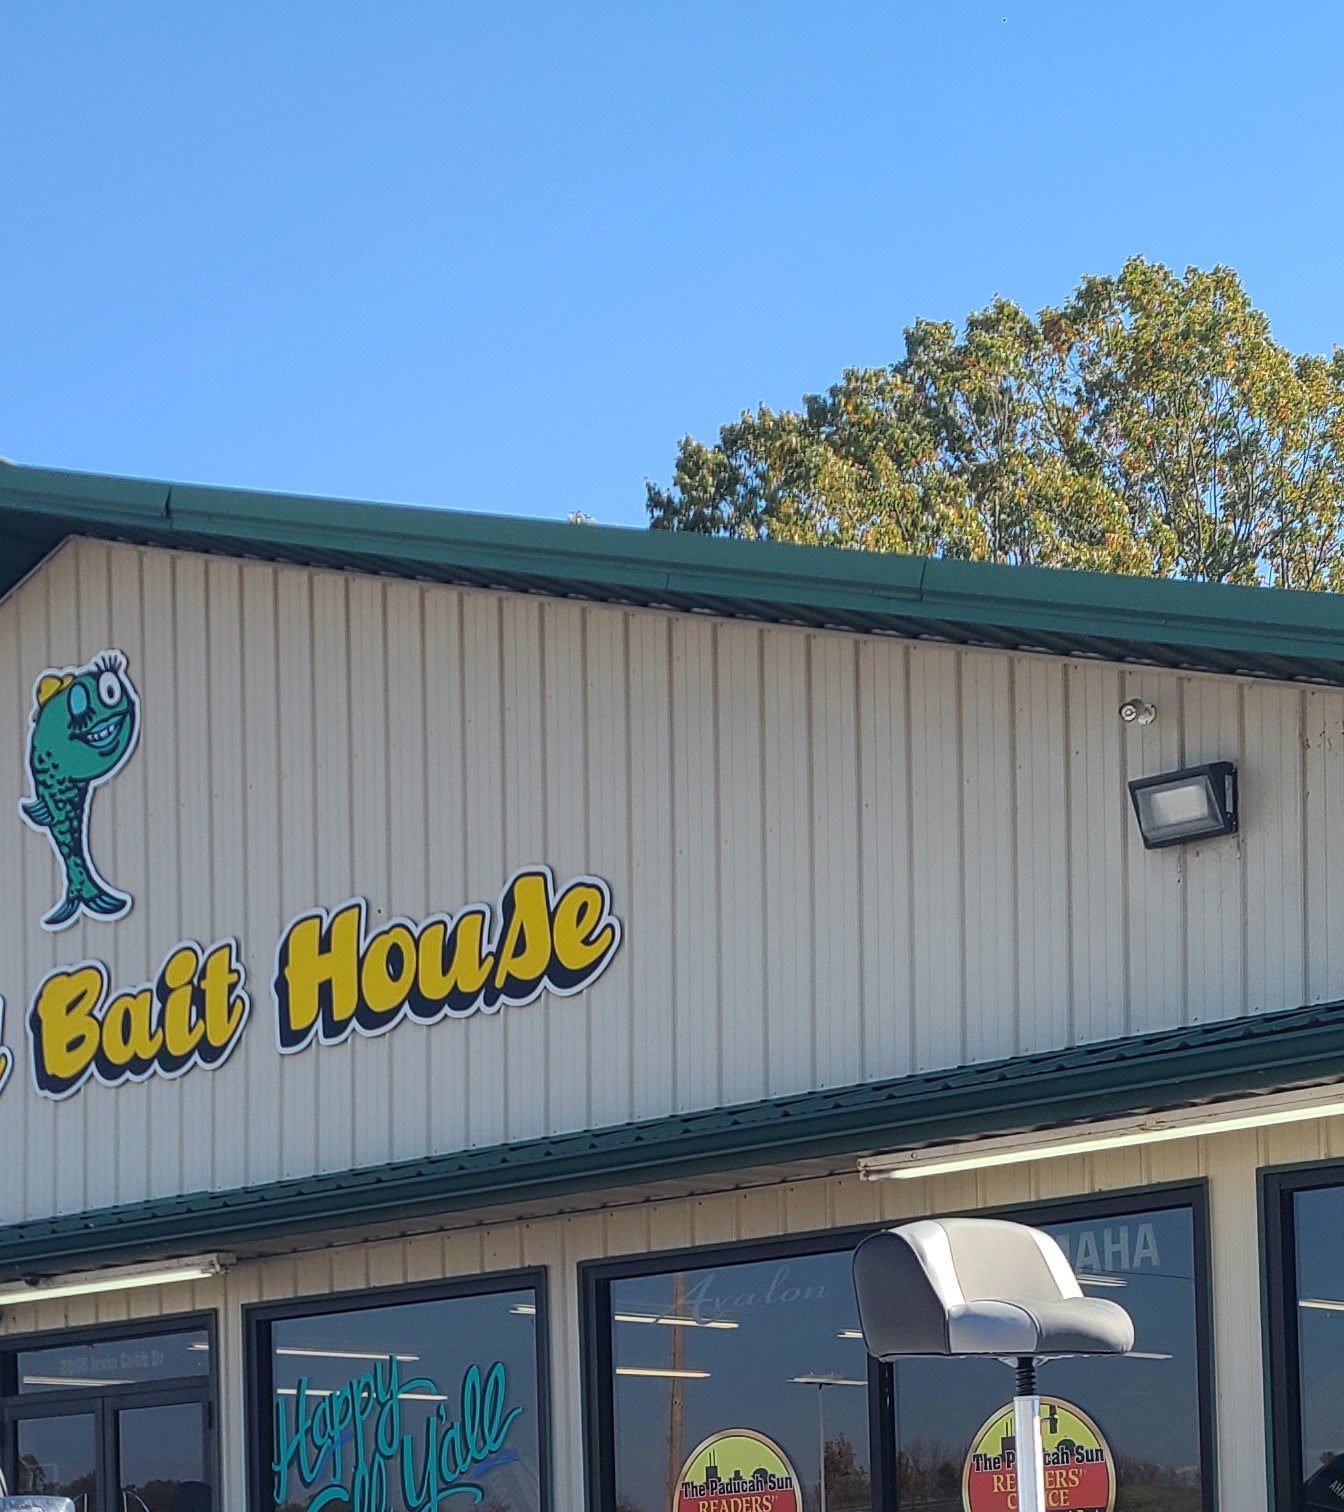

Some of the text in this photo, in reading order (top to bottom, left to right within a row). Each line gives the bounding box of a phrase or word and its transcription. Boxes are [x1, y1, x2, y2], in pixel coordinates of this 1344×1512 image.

[30, 940, 247, 1095] Bait
[277, 867, 618, 1051] House
[650, 1264, 827, 1325] Avalon
[272, 1355, 437, 1503] Happy
[973, 1453, 1001, 1471] The
[1075, 1445, 1105, 1463] Sun
[682, 1474, 793, 1499] The Paducah Sun
[993, 1468, 1083, 1493] REERS'
